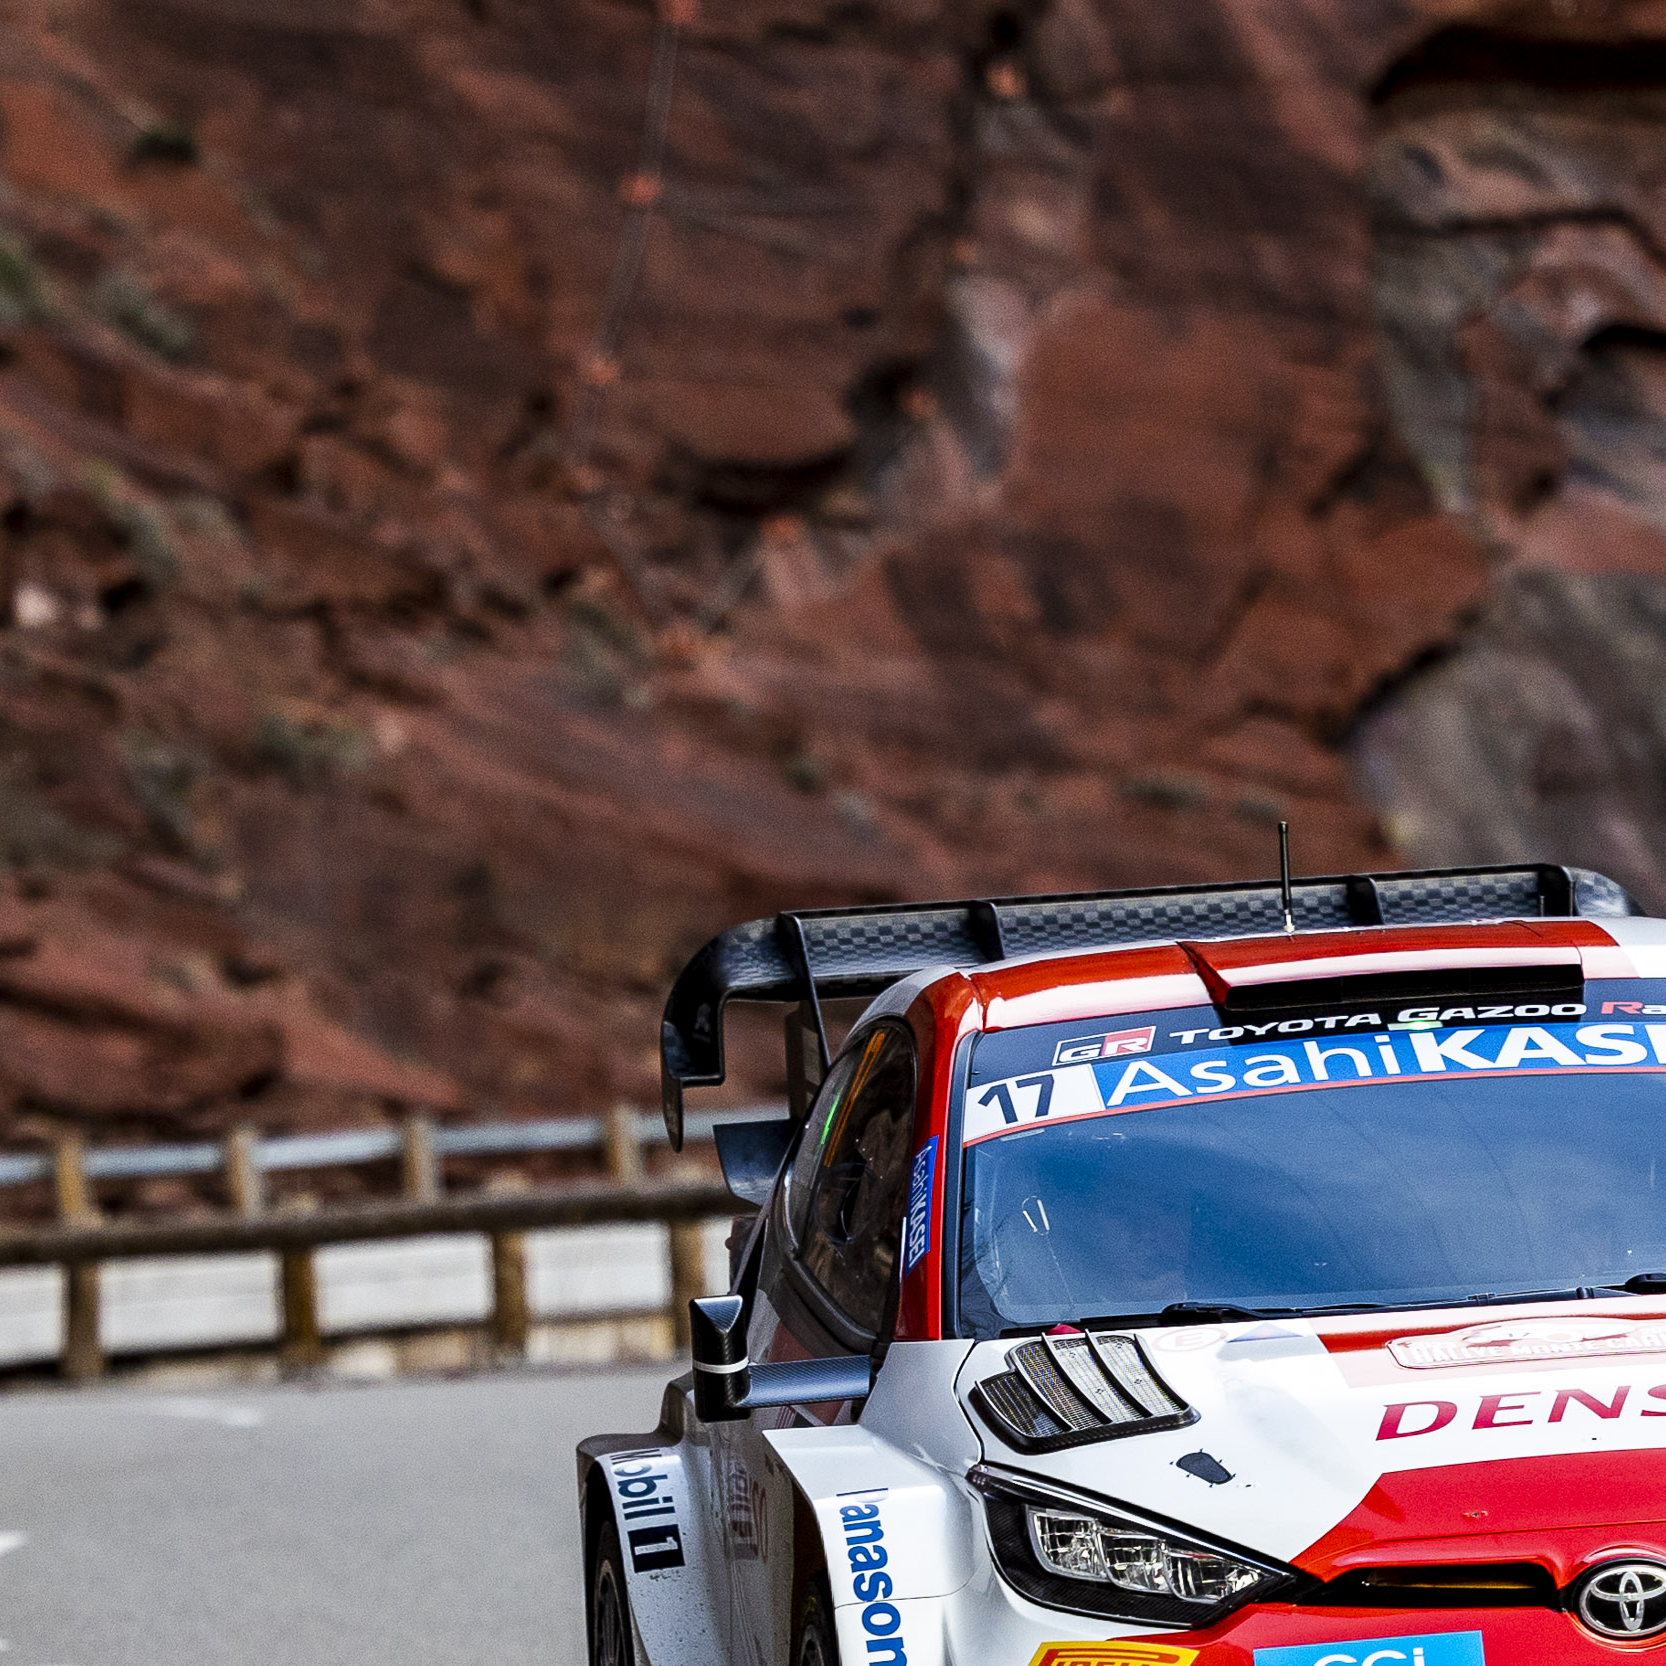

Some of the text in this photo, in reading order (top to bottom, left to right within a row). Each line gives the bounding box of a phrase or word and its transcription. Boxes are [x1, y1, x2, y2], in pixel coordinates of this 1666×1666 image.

[1059, 1036, 1148, 1062] GR
[1170, 1013, 1381, 1045] TOYOTA
[1397, 1002, 1587, 1023] GAZOO
[978, 1074, 1056, 1125] 17
[609, 1448, 676, 1520] Mobil
